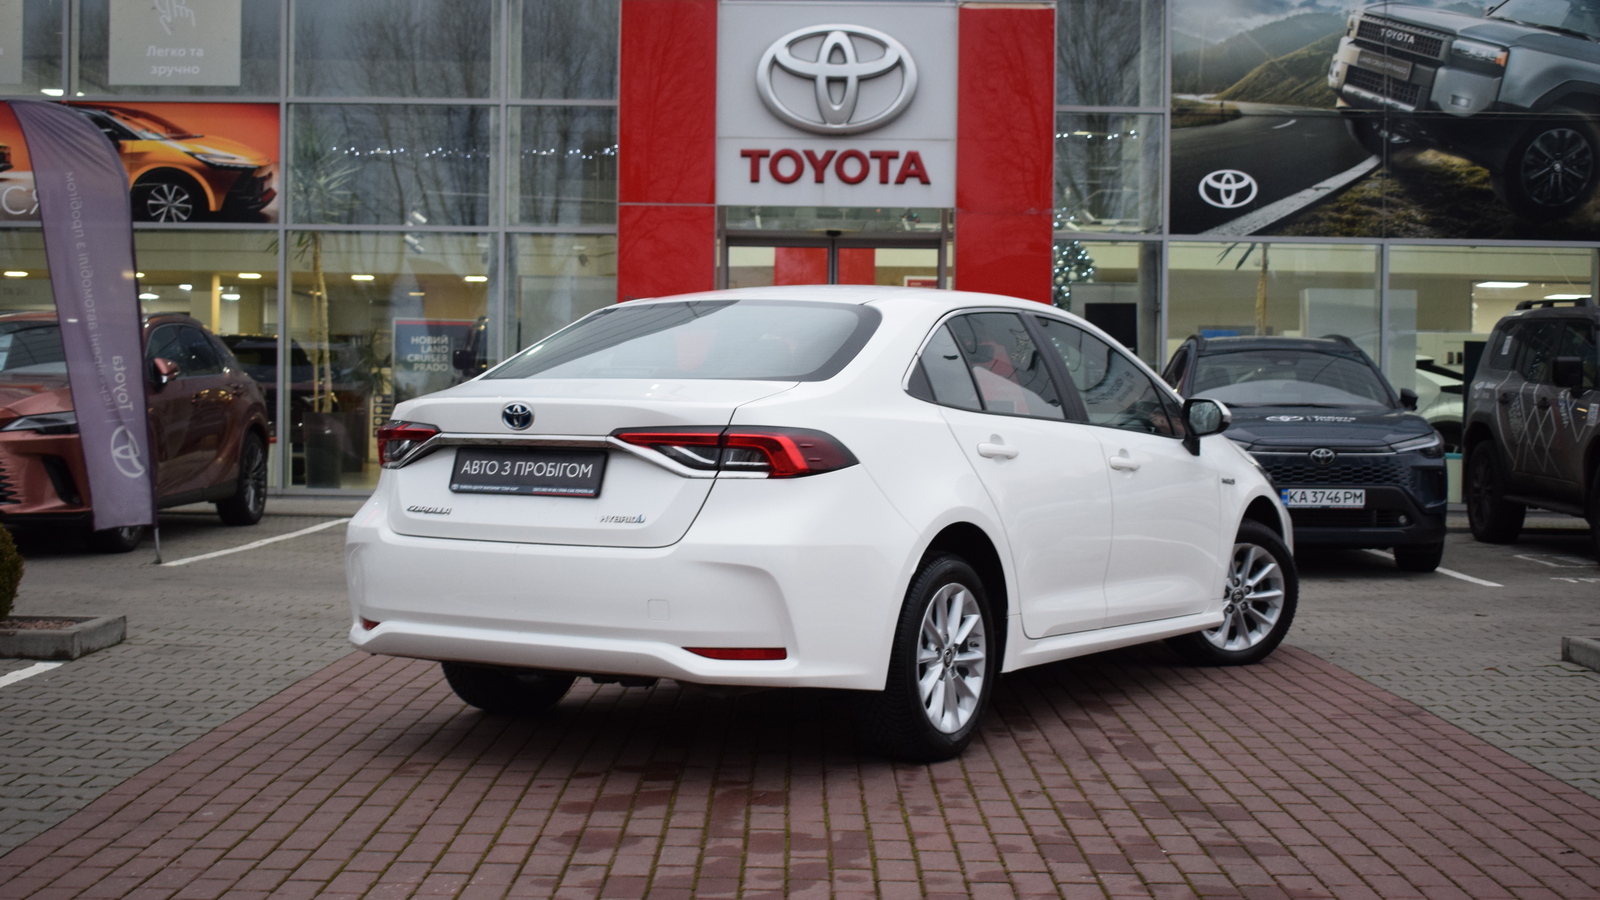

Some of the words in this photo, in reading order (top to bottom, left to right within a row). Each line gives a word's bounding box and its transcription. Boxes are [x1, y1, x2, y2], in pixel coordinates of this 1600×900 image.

[1381, 28, 1415, 44] TOYOTA
[146, 45, 185, 58] Легко
[188, 47, 204, 58] та
[150, 65, 201, 77] зручно
[740, 148, 932, 186] TOYOTA
[411, 334, 449, 345] НОВИЙ
[421, 345, 449, 354] LAND
[407, 353, 449, 363] CRUISER
[413, 363, 449, 372] PRADO
[460, 460, 499, 475] АВТО
[513, 461, 594, 478] ПРОБІГОМ
[1288, 491, 1308, 504] KA
[1311, 491, 1341, 504] 3746
[1343, 491, 1363, 504] PM
[600, 515, 642, 524] HYBRID
